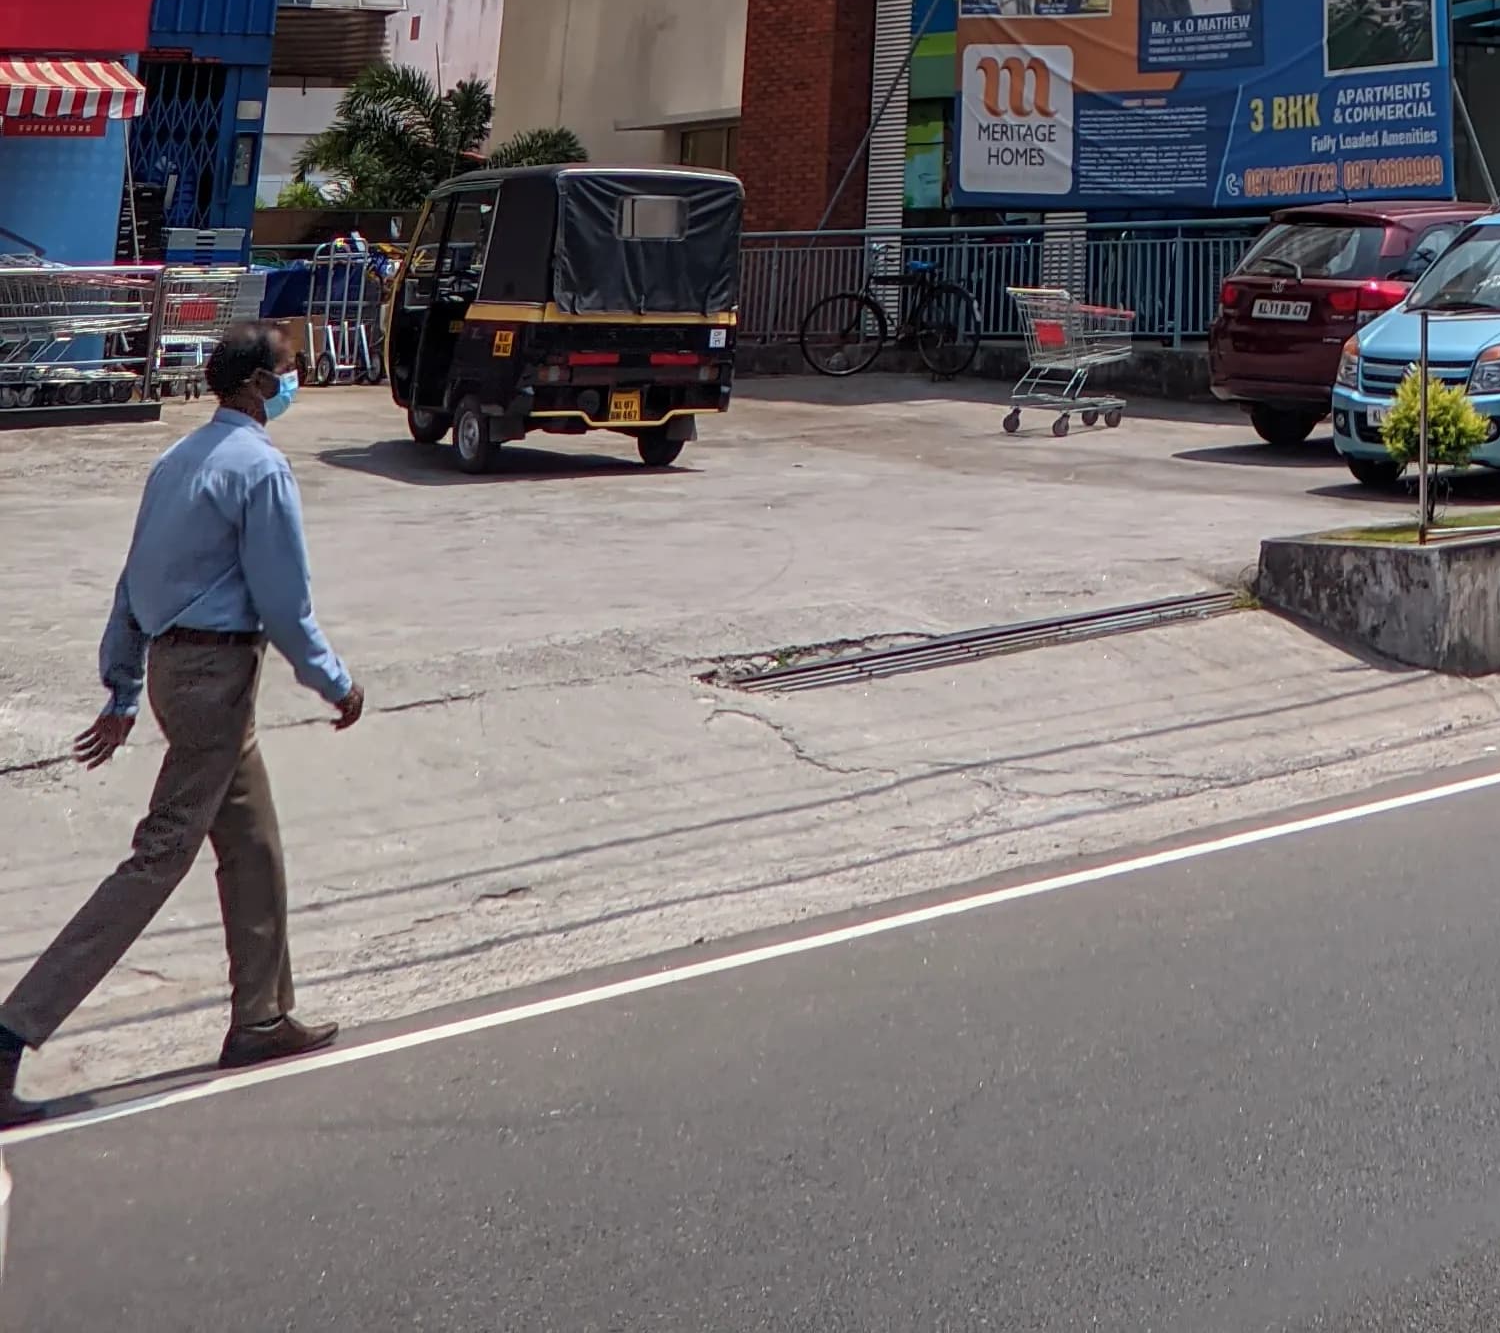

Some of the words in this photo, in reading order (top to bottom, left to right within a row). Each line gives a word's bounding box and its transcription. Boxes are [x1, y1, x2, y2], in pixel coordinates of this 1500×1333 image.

[1151, 21, 1170, 34] Mr.
[1197, 14, 1251, 31] MATHEW
[1336, 82, 1431, 107] APARTMENTS
[1250, 98, 1264, 133] 3
[1272, 93, 1321, 131] BHK
[1333, 108, 1343, 124] &
[1344, 102, 1436, 124] COMMERCIAL
[978, 122, 1057, 143] MERITAGE
[1311, 135, 1336, 154] Fully
[1339, 132, 1378, 150] Loaded
[1381, 127, 1438, 147] Amenities
[987, 146, 1045, 166] HOMES
